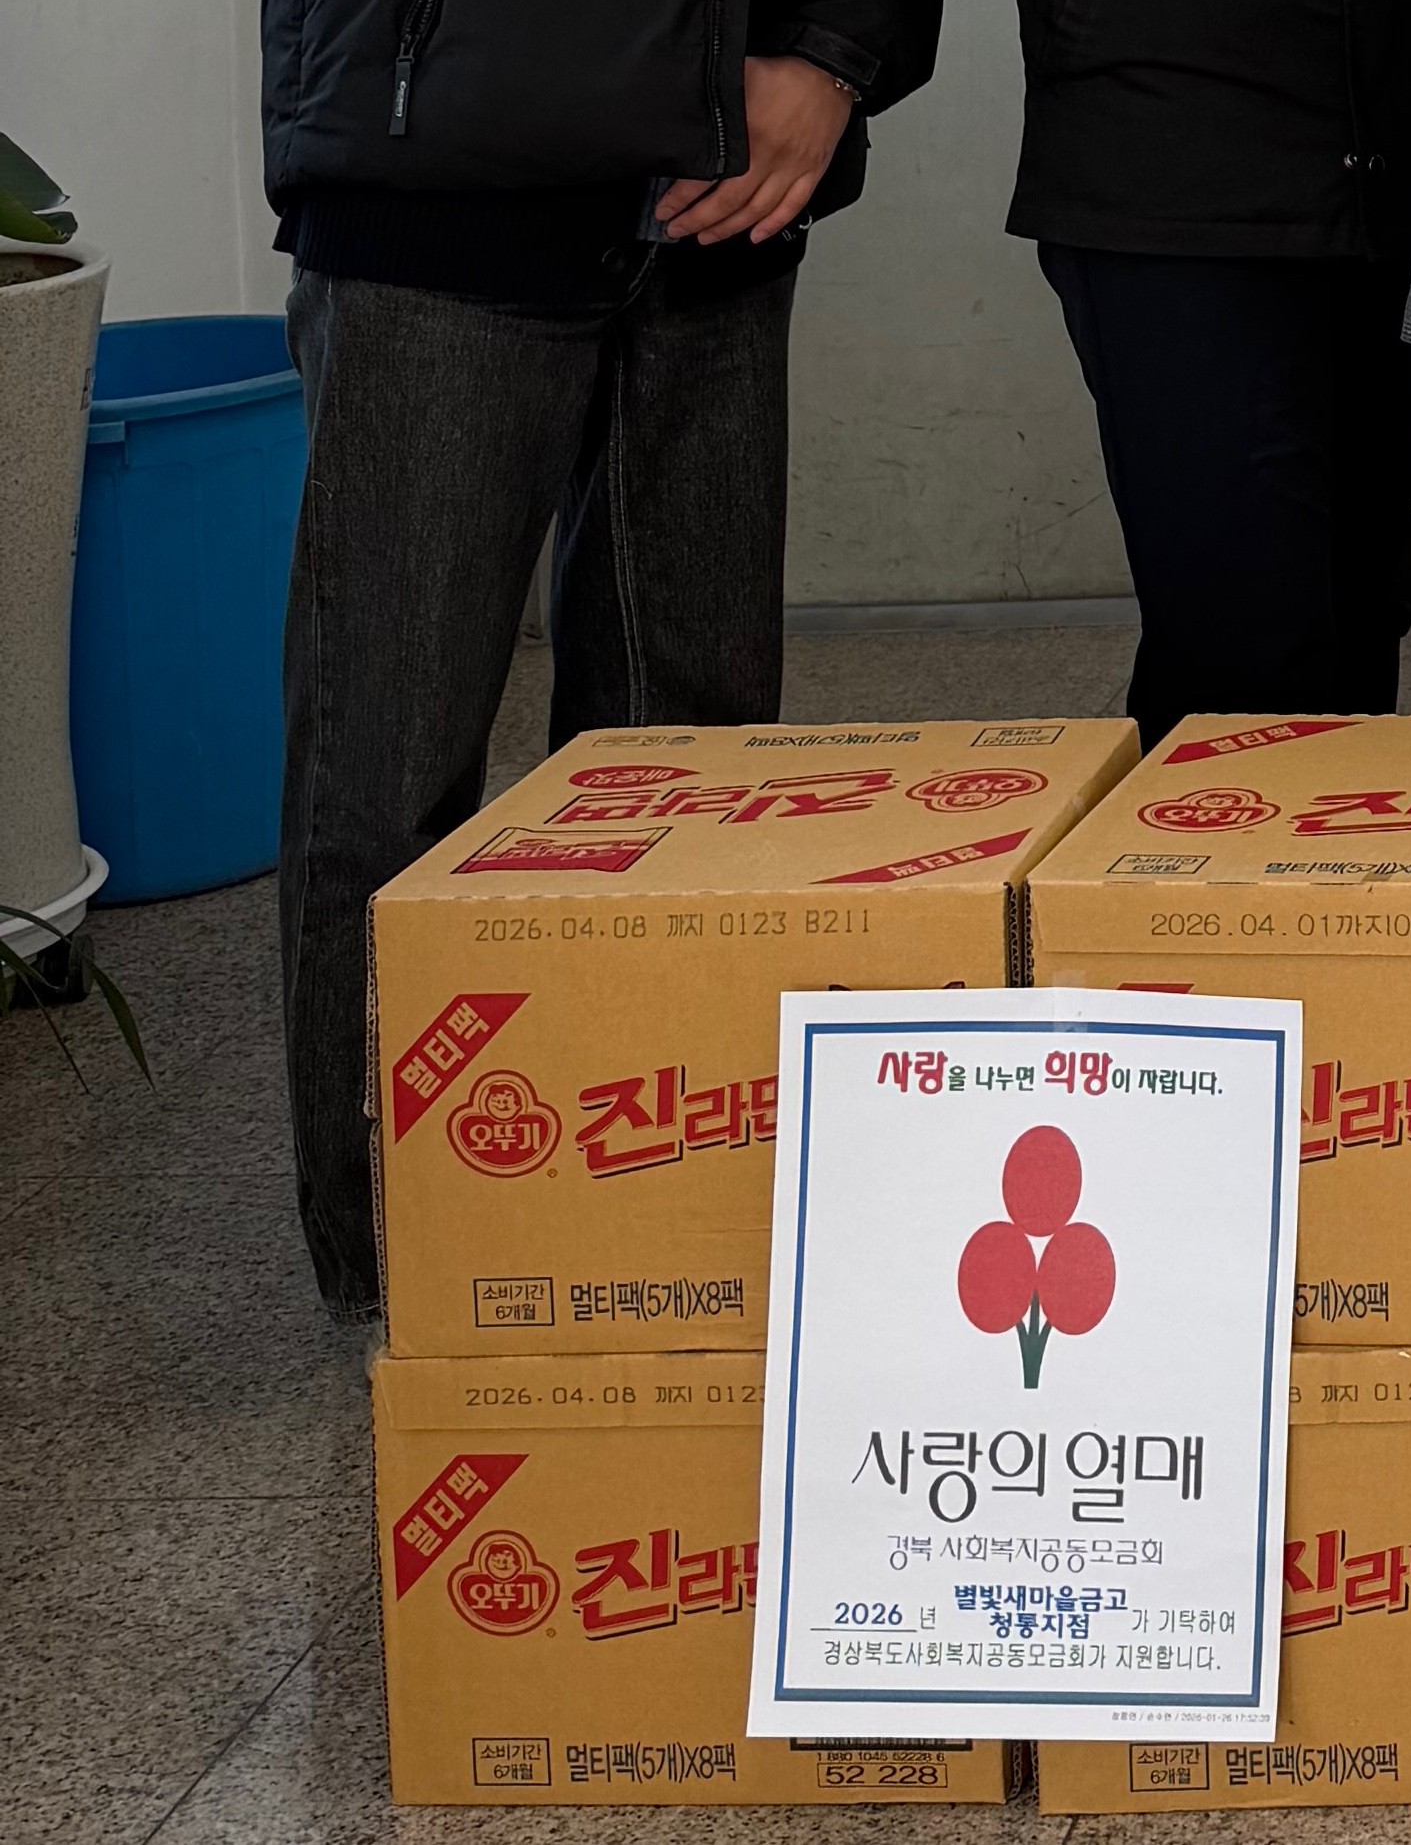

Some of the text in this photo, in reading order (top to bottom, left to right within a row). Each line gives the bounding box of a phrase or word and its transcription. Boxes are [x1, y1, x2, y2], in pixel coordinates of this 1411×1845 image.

[545, 767, 902, 826] 진라면
[475, 909, 870, 943] 2026.04.08 까지 0123 B211
[399, 1004, 491, 1095] 멀티팩
[876, 1050, 1223, 1097] 사랑을 나누면 희망이 자랍니다.
[467, 1124, 544, 1153] 오뚜기
[481, 1282, 545, 1302] 소비기간
[570, 1282, 744, 1321] 멀티팩(5개)X8팩
[495, 1303, 537, 1321] 6개월
[466, 1387, 637, 1407] 2026.04.08
[655, 1386, 693, 1404] 까지
[1321, 1384, 1358, 1404] 까지
[851, 1430, 1204, 1524] 사랑의 열매
[400, 1462, 488, 1556] 멀티팩
[887, 1534, 1163, 1574] 경북 사회복지공동모금회
[468, 1582, 540, 1611] 오뚜기
[573, 1528, 758, 1640] 진라
[834, 1585, 1235, 1639] 2026 년 별빛새마을금고 청통지점 가 기탁하여
[824, 1640, 1221, 1671] 경상북도사회복지공동모금회가 지원합니다.
[480, 1744, 542, 1761] 소비기간
[566, 1744, 736, 1782] 멀티팩(5개)X8팩
[1137, 1748, 1199, 1765] 소비기간
[1227, 1744, 1399, 1786] 멀티팩(5개)X8팩
[493, 1763, 534, 1781] 6개월
[825, 1766, 938, 1785] 52 228
[1151, 1768, 1190, 1785] 6개월
